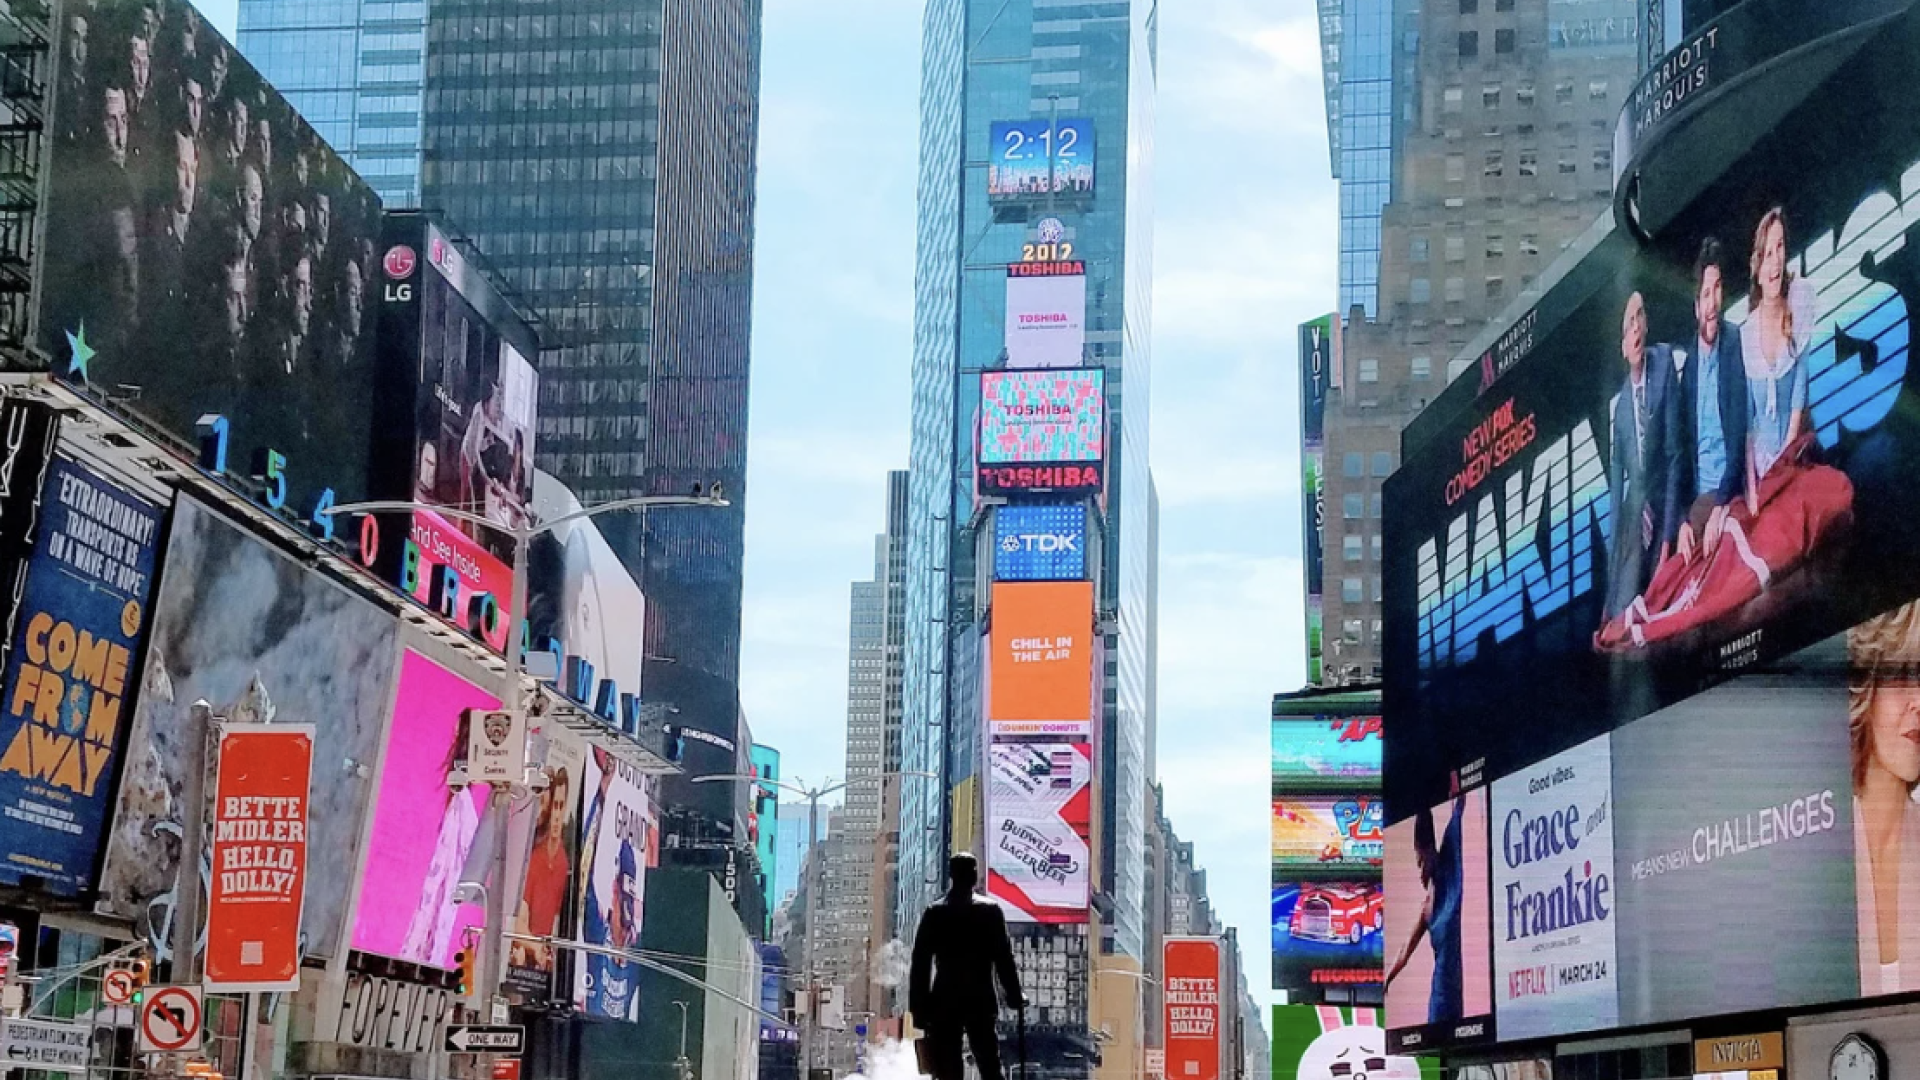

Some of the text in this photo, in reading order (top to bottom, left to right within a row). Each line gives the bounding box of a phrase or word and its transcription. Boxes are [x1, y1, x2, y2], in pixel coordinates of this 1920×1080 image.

[1636, 27, 1718, 111] MARRIOTT
[1636, 65, 1705, 138] MARQUIS
[1004, 127, 1077, 160] 2:12
[1009, 262, 1084, 275] TOSHIBA
[384, 284, 412, 302] LG
[1018, 313, 1068, 323] TOSHIBA
[1004, 404, 1072, 415] TOSHIBA
[1463, 396, 1514, 463] NEW FOX
[1444, 412, 1536, 507] COMEDY SERIES
[196, 413, 379, 568] 1540
[981, 466, 1100, 488] TOSHIBA
[411, 514, 480, 583] And See Inside
[1019, 533, 1077, 551] TDK
[26, 612, 129, 697] COME
[1011, 636, 1072, 650] CHILL IN
[1011, 649, 1070, 663] THE AIR
[0, 720, 111, 797] AWAY
[1528, 772, 1550, 795] Good
[224, 796, 301, 819] BETTE
[216, 820, 304, 843] MIDLER
[1503, 804, 1580, 869] Grace
[1666, 846, 1691, 869] NEW
[1692, 789, 1835, 863] CHALLENGES
[222, 846, 298, 873] HELLO,
[221, 870, 297, 895] DOLLY!
[1505, 860, 1610, 942] Frankie
[1169, 977, 1216, 991] BETTE
[1508, 960, 1608, 1000] NETFLIX MARCH 24
[1166, 990, 1218, 1004] MIDLER
[336, 972, 448, 1054] FOREVER
[467, 1033, 515, 1045] ONE WAY
[1711, 1037, 1762, 1065] INVICTA
